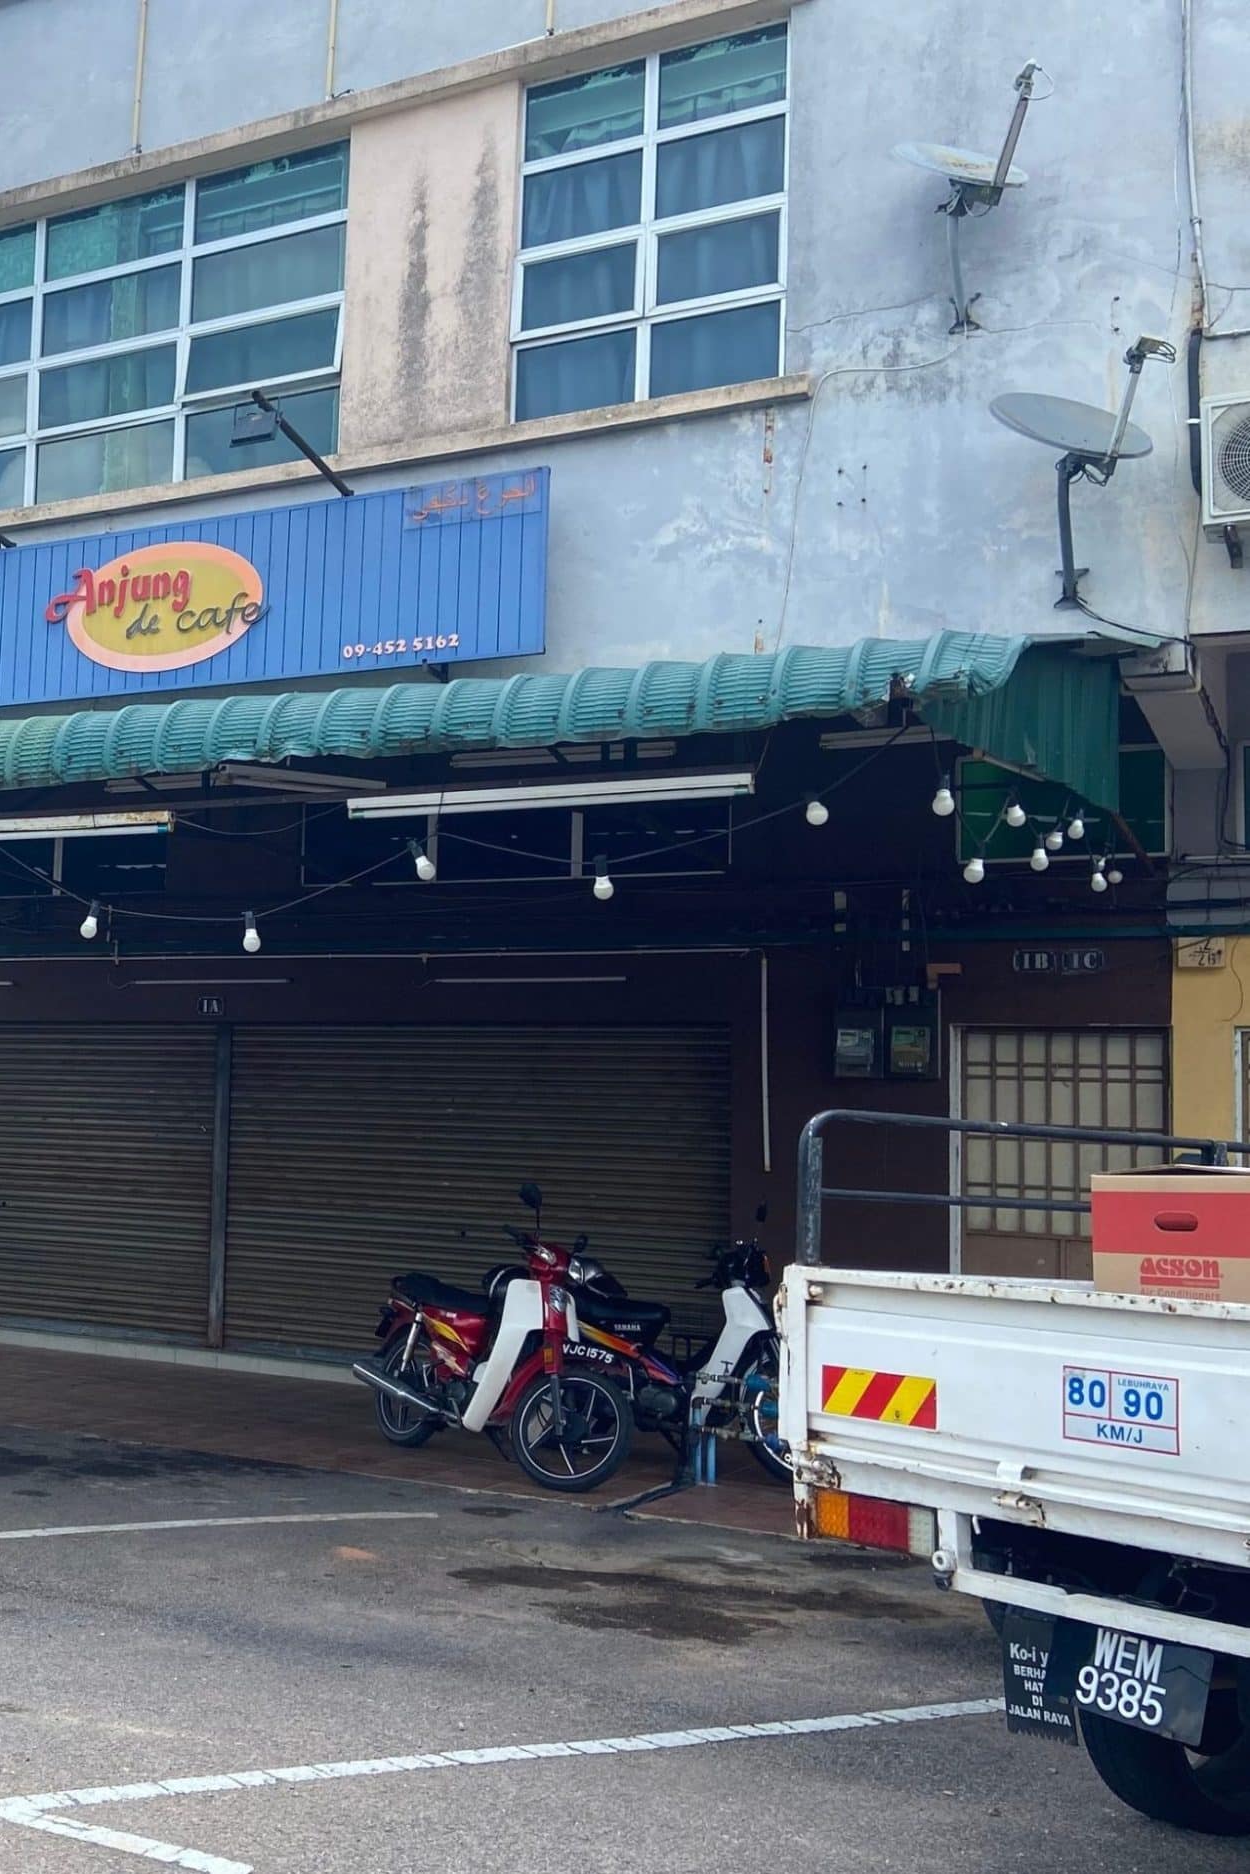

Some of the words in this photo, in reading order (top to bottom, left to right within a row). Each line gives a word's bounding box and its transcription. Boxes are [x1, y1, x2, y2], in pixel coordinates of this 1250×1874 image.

[45, 564, 193, 624] Anjung
[125, 602, 161, 639] de
[176, 592, 271, 634] cafe
[343, 639, 407, 658] 09-452
[413, 634, 460, 651] 5162
[562, 1343, 614, 1364] VJC1575
[1117, 1378, 1169, 1391] LEBUHRAYA
[1068, 1377, 1105, 1408] 80
[1124, 1388, 1163, 1420] 90
[1096, 1423, 1143, 1444] KM/J
[1094, 1627, 1163, 1684] WEM
[1032, 1694, 1043, 1707] DI
[1075, 1665, 1166, 1726] 9385
[1009, 1704, 1041, 1720] JALAN
[1043, 1710, 1071, 1727] RAYA
